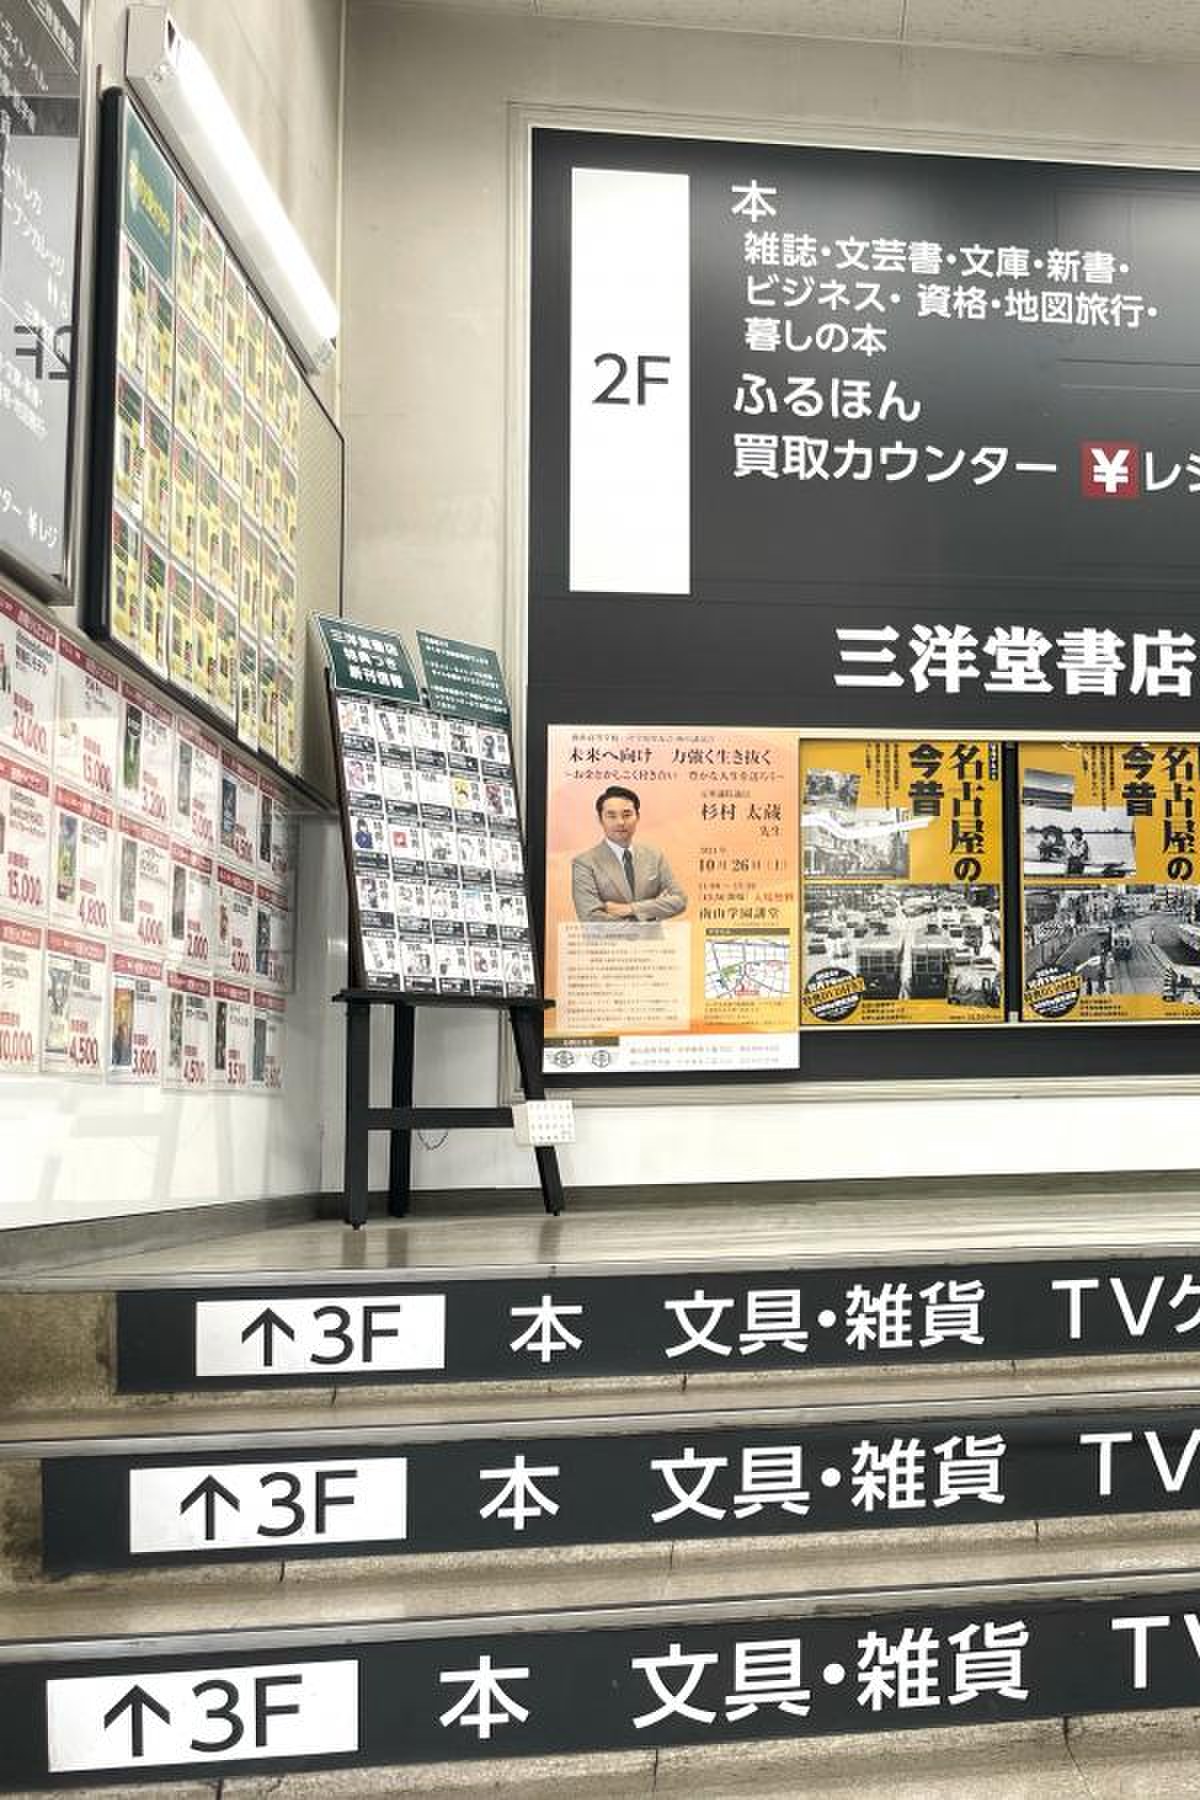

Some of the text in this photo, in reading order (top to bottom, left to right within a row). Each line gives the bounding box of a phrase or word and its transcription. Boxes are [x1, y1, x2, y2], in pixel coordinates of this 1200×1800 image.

[731, 180, 776, 222] 本
[745, 317, 886, 356] 暮しの本
[592, 353, 670, 405] 2F
[734, 374, 921, 421] ふるほん
[734, 434, 1056, 485] 買取カウンター
[833, 623, 1197, 697] 三洋堂書店
[909, 743, 945, 817] 今昔
[950, 743, 985, 882] 名古屋の
[1122, 745, 1157, 817] 今昔
[1163, 746, 1195, 881] 名古屋の
[310, 1305, 401, 1366] 3F
[510, 1296, 583, 1362] 本
[665, 1280, 985, 1359] 文具・雑貨
[257, 1470, 358, 1538] 3F
[480, 1456, 559, 1530] 本
[650, 1435, 1007, 1524] 文具・雑貨
[191, 1674, 303, 1753] 3F
[440, 1656, 530, 1739] 本
[631, 1620, 1029, 1730] 文具・雑貨
